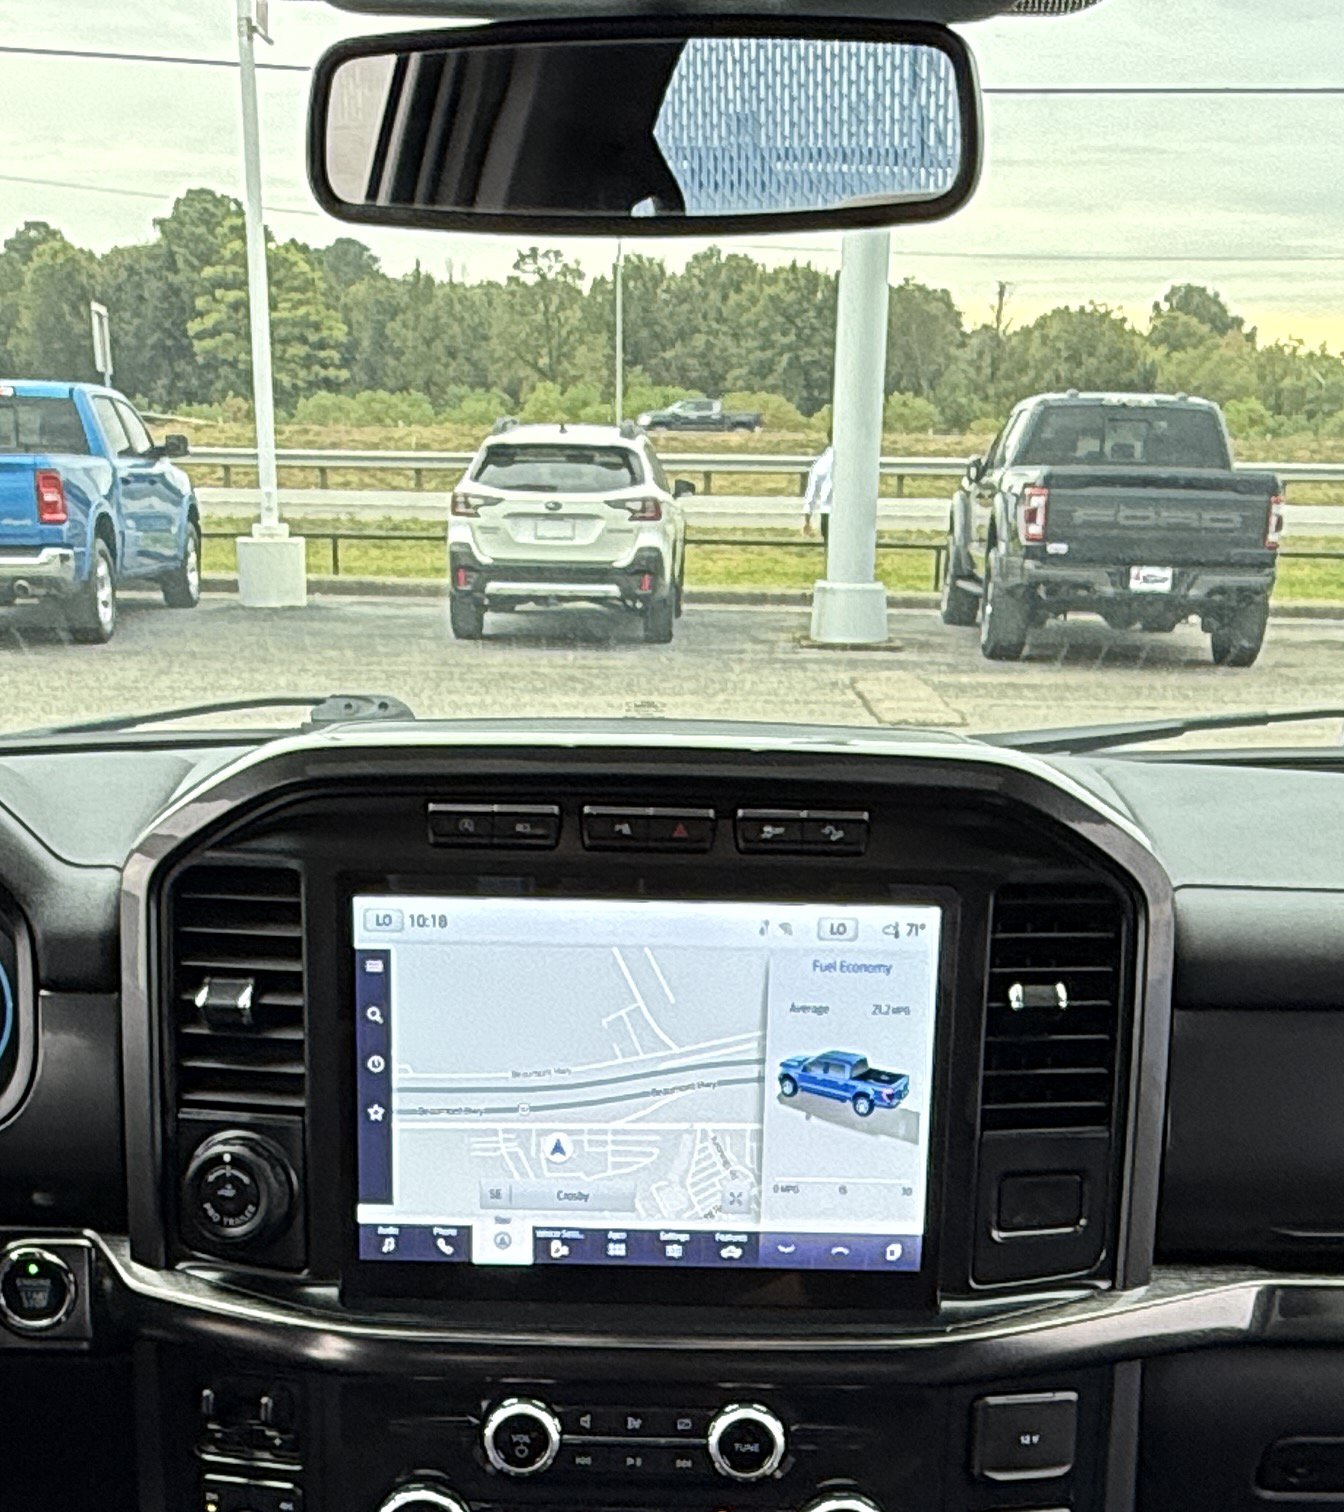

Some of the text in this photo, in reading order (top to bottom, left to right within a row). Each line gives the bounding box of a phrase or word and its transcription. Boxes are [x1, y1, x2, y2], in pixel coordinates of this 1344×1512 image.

[1072, 506, 1243, 529] FORD
[375, 913, 393, 927] LO
[829, 922, 848, 936] LO
[812, 959, 893, 976] Fuel Economy
[789, 1002, 830, 1016] Average
[557, 1189, 590, 1203] Crosby
[203, 1202, 257, 1226] PRO TRAILER
